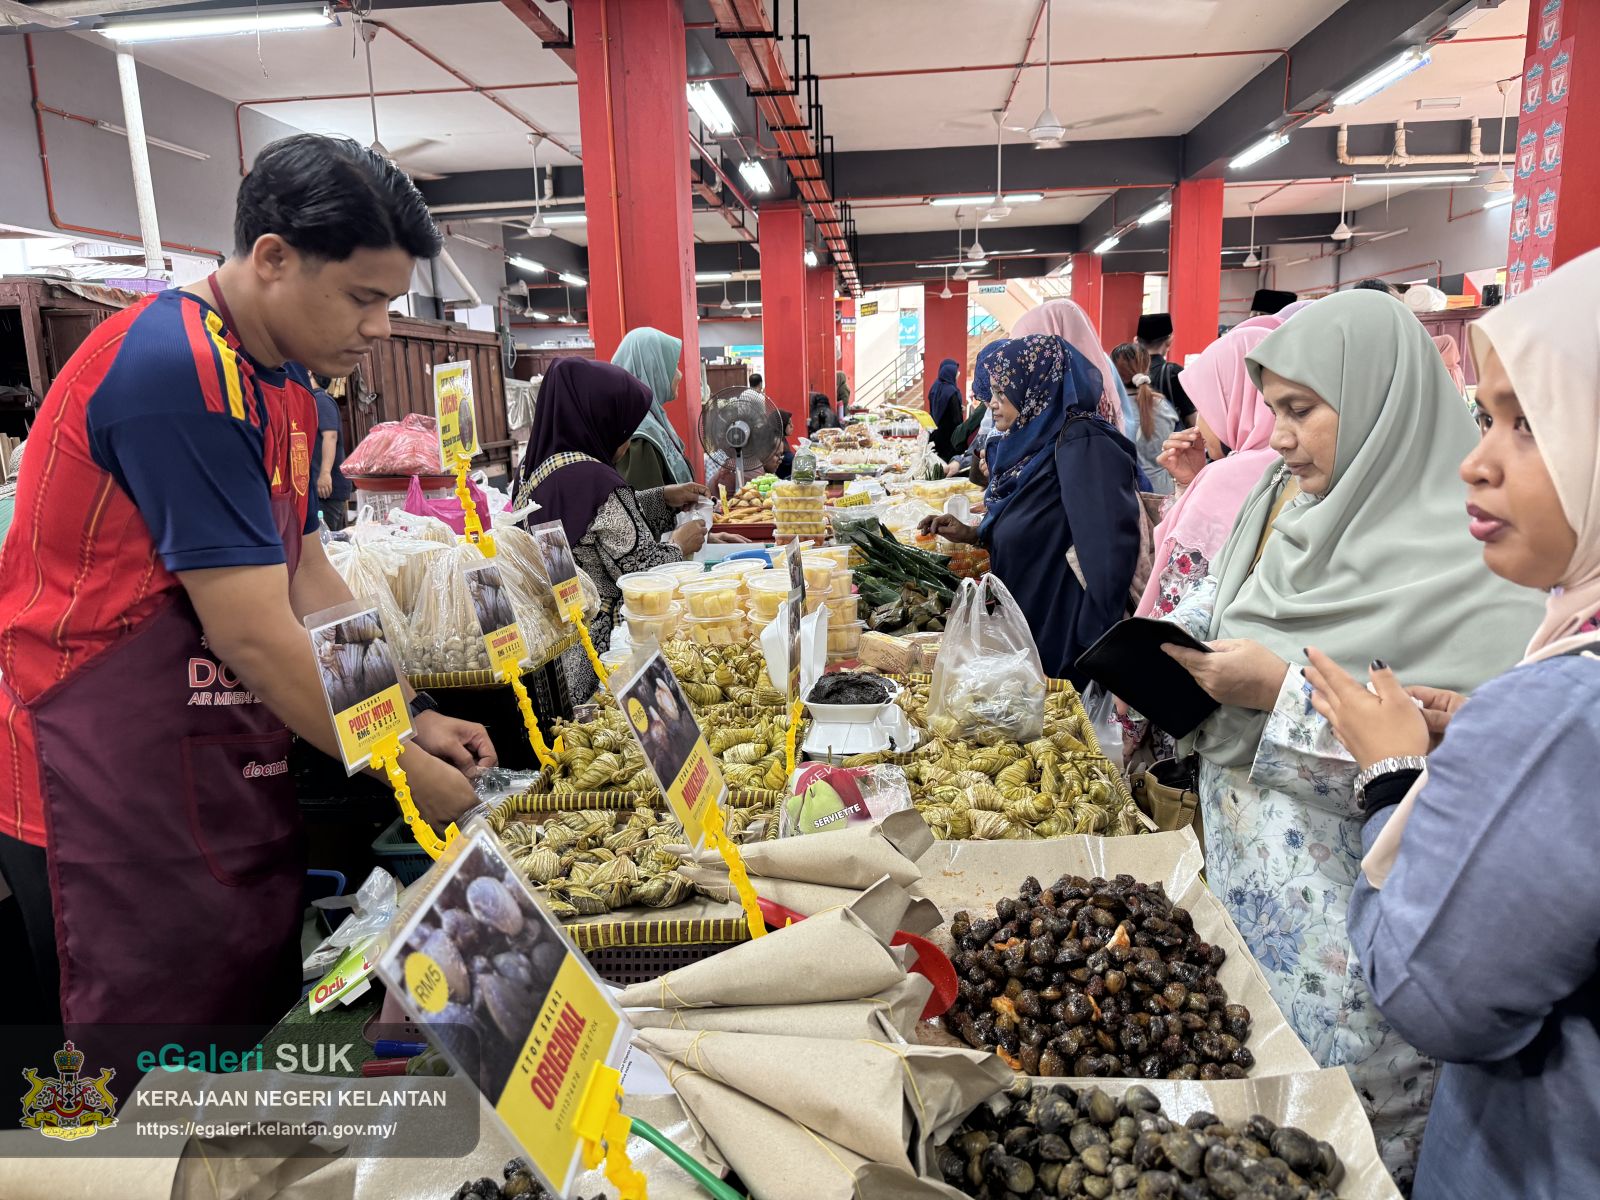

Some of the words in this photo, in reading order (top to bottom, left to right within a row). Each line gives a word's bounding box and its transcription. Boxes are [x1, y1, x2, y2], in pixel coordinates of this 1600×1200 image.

[187, 691, 212, 706] AIR
[348, 710, 372, 734] PULUT
[371, 698, 395, 722] HITAM
[681, 756, 710, 811] MUKBANG
[814, 803, 861, 828] SERVIETTE
[415, 964, 442, 1004] RM5
[521, 1035, 542, 1074] ETOK
[530, 1000, 588, 1111] ORIGINAL
